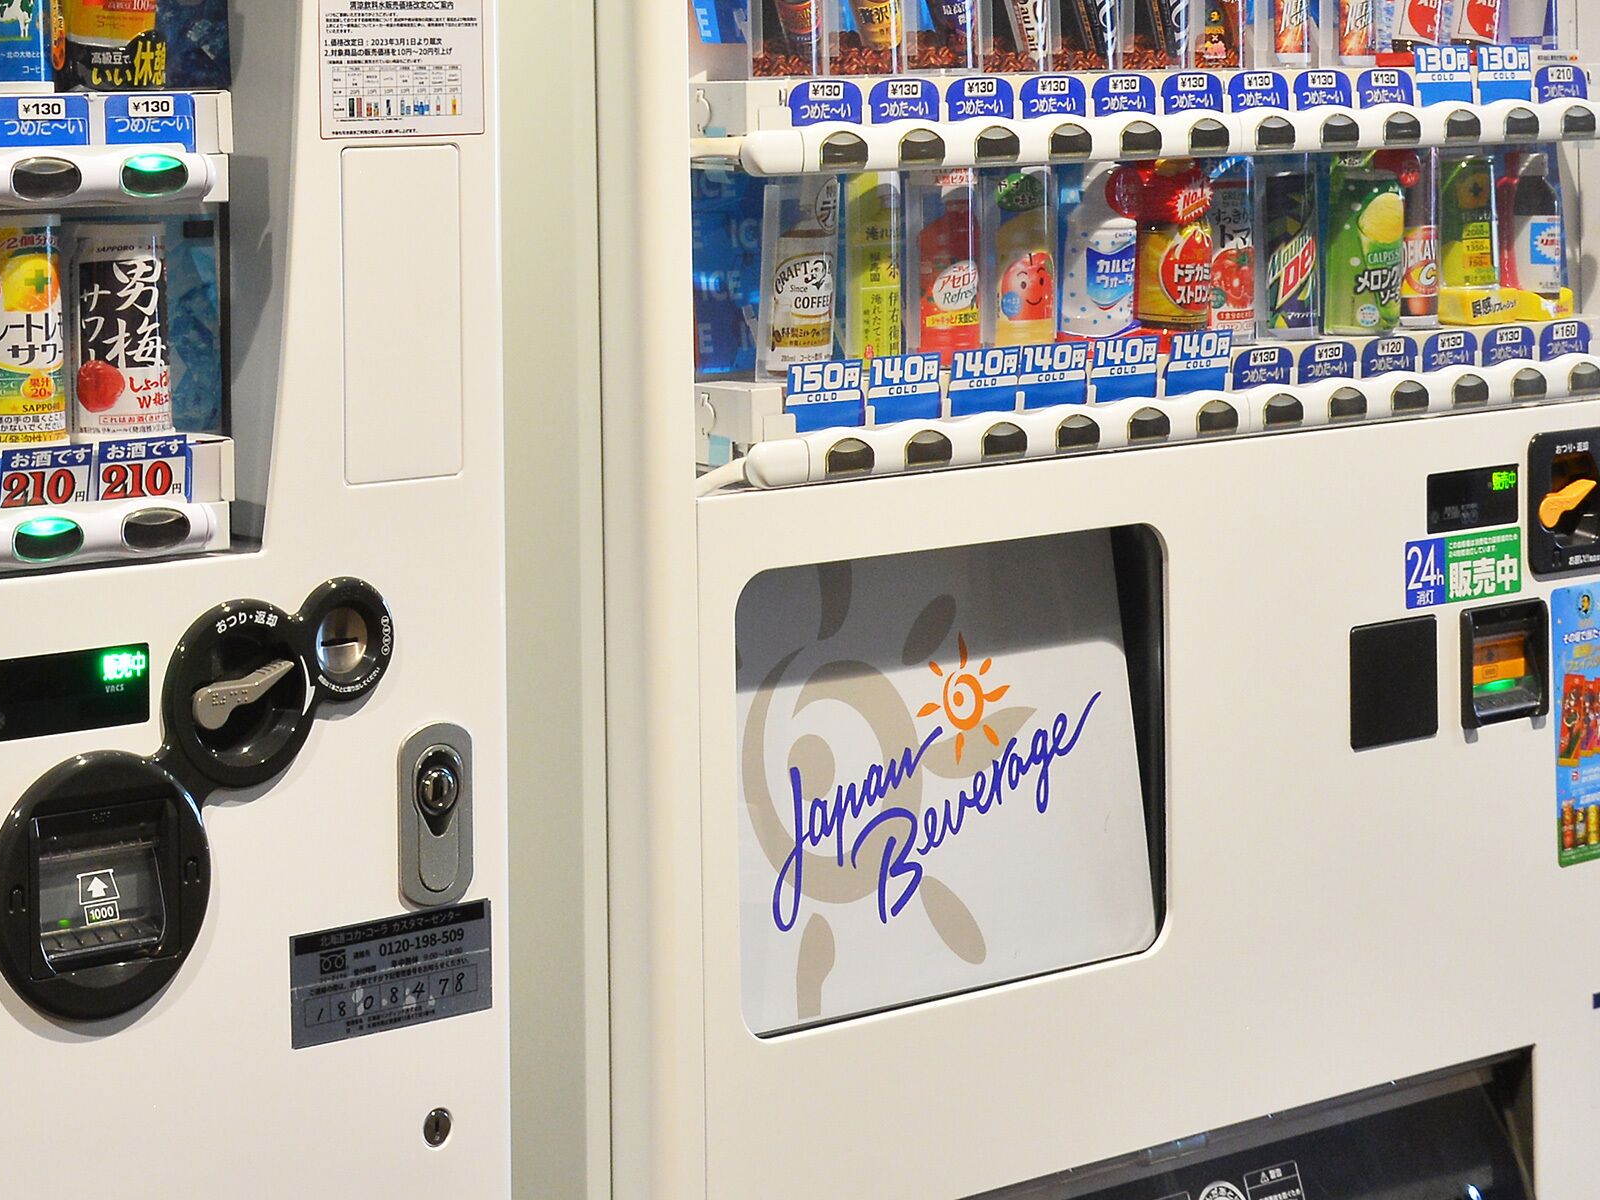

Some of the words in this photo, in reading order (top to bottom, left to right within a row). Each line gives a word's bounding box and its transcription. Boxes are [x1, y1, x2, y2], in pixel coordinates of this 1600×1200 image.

[812, 84, 840, 98] ¥130
[967, 81, 993, 94] ¥130
[23, 102, 62, 117] ¥130
[800, 103, 851, 119] つめた〜い
[105, 259, 166, 368] 男梅
[1554, 325, 1576, 337] ¥160
[1173, 332, 1231, 360] 140円
[1252, 350, 1276, 364] ¥130
[790, 362, 861, 392] 150円
[872, 356, 939, 385] 140円
[807, 391, 837, 402] COLD
[106, 439, 185, 464] お酒です
[102, 460, 182, 499] 210円
[1406, 543, 1444, 590] 24h
[1448, 553, 1518, 599] 販売中
[1416, 589, 1434, 605] 消灯
[214, 609, 280, 635] おつり・返却
[851, 690, 1102, 926] Beverage
[772, 725, 943, 933] Japan
[89, 905, 115, 921] 1000
[391, 910, 462, 932] カスタマーセンター
[379, 927, 465, 957] 0120-198-509
